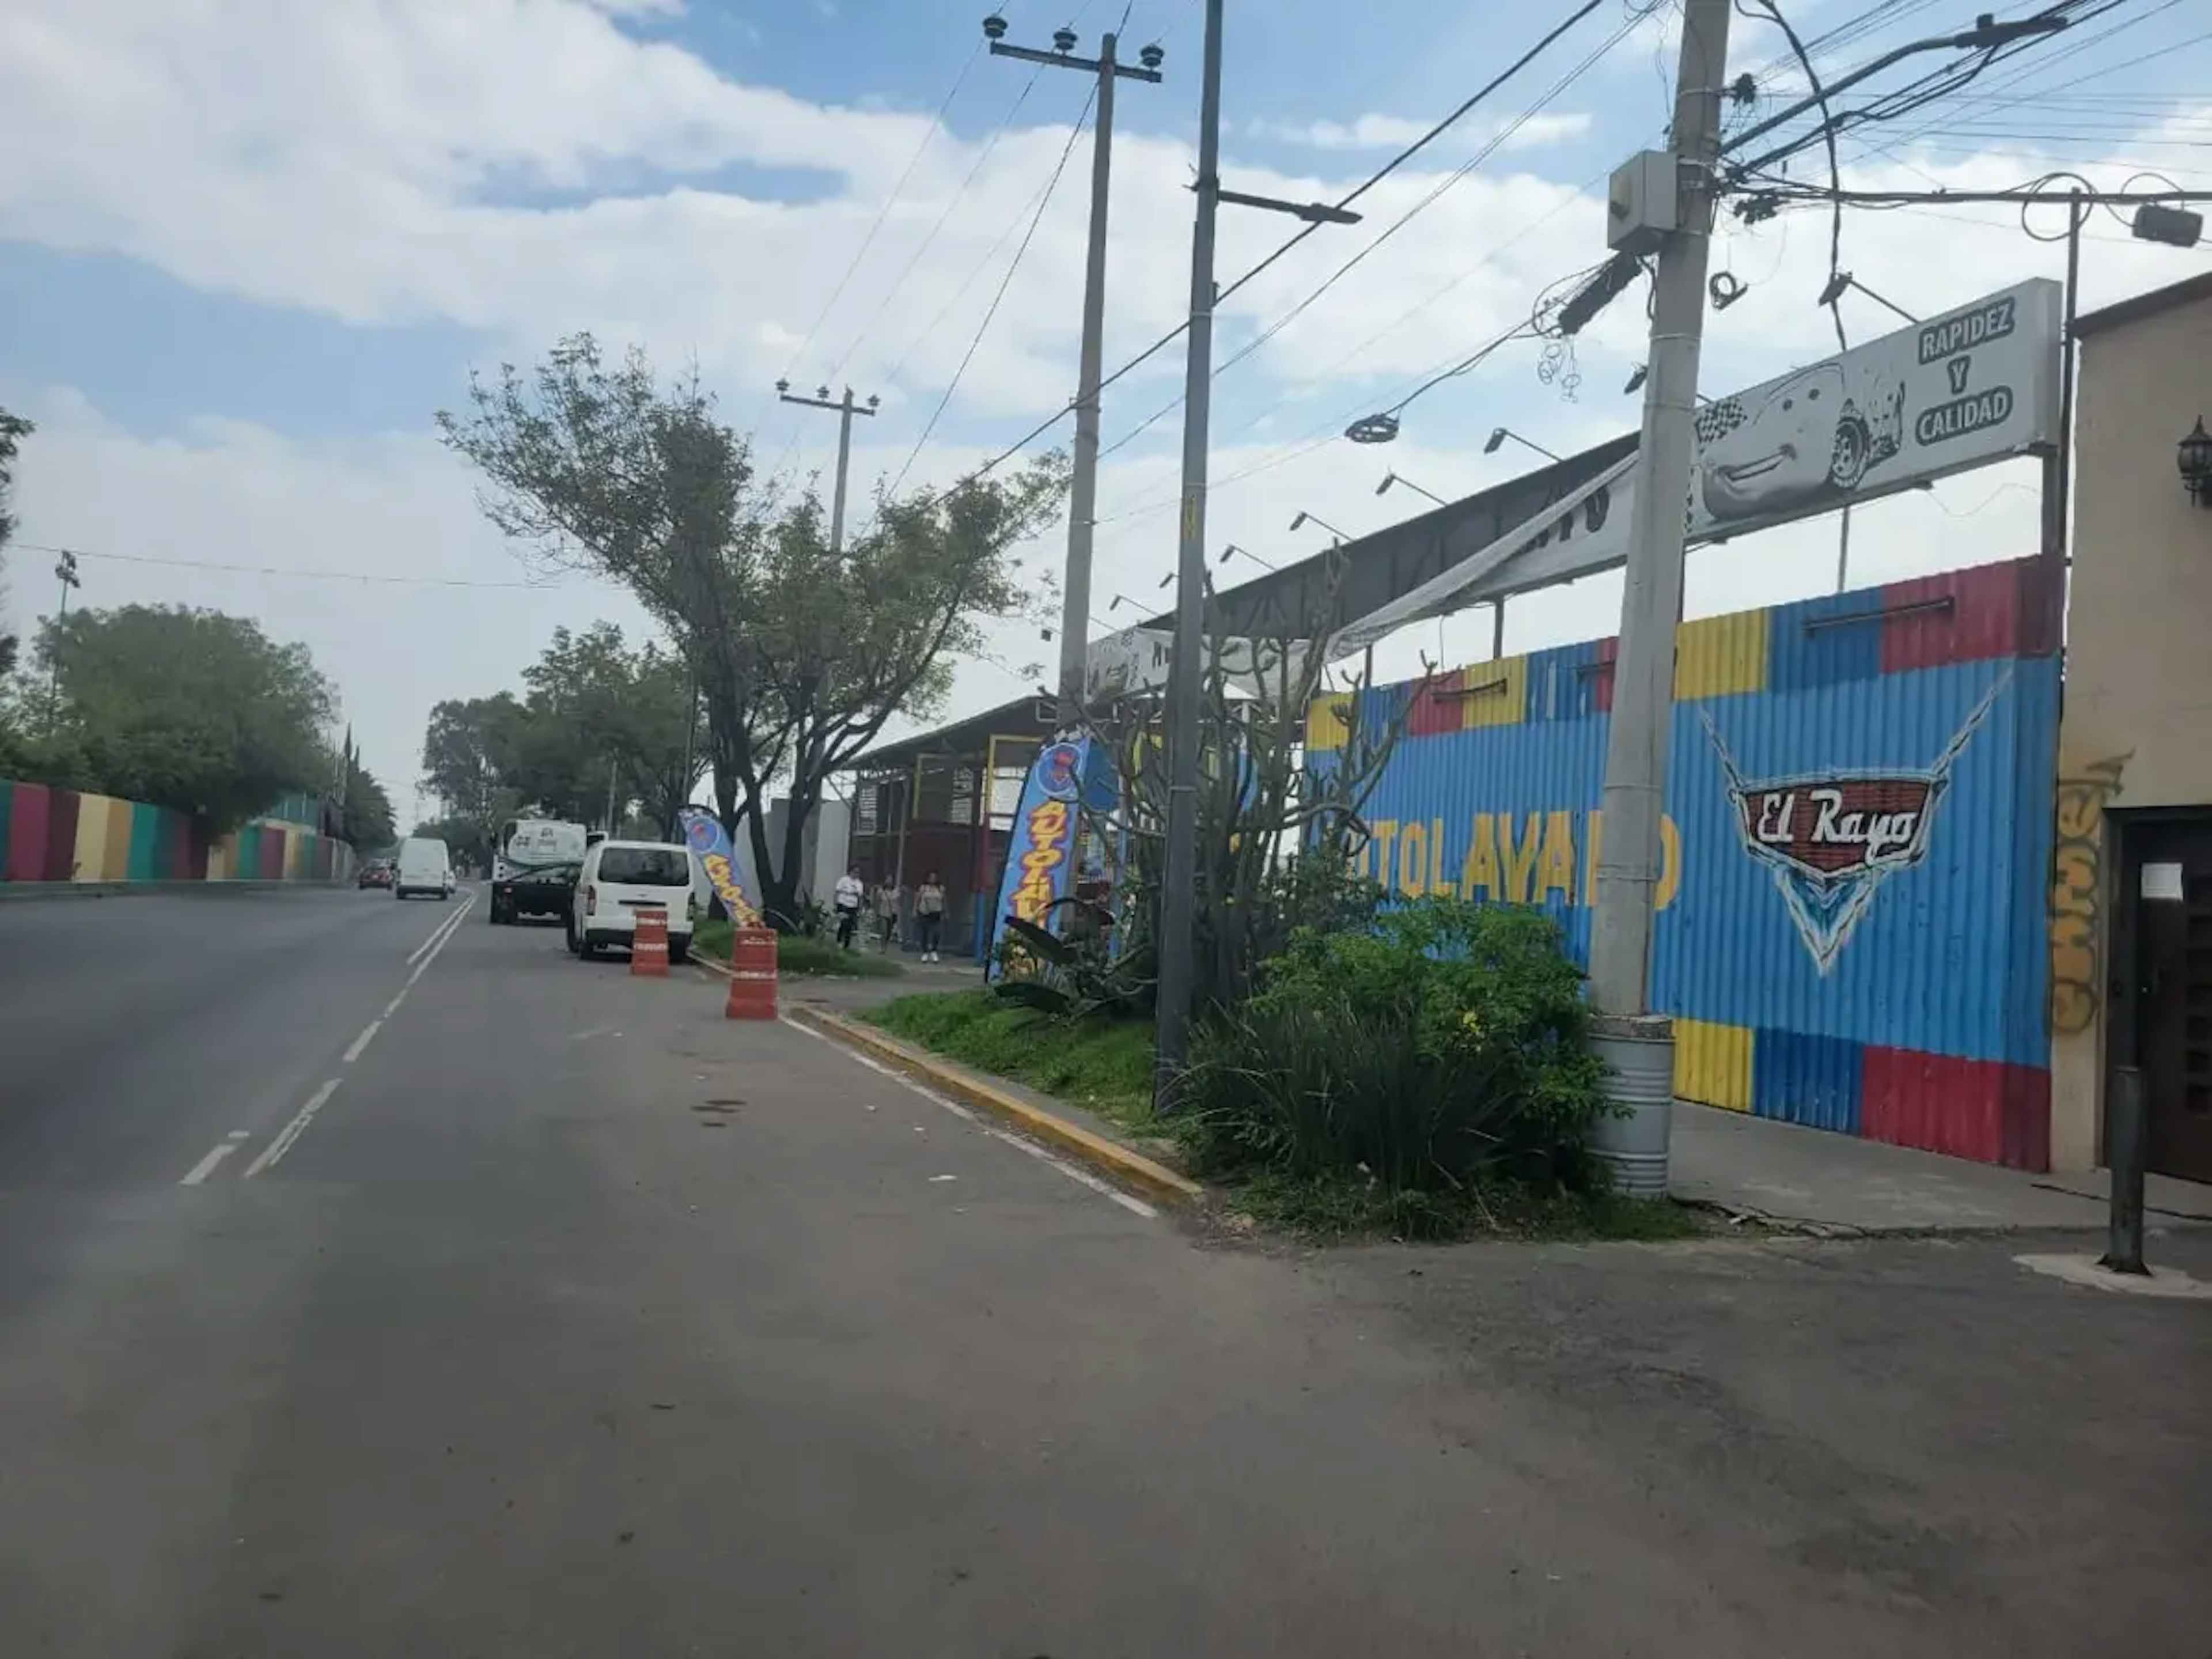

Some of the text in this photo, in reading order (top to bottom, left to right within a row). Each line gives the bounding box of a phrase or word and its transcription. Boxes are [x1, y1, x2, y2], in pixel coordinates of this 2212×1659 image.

[1922, 301, 2011, 360] RAPIDEZ
[1950, 358, 1968, 392] Y
[1918, 391, 2009, 441] CALIDAD
[1758, 788, 1918, 866] El Rayo
